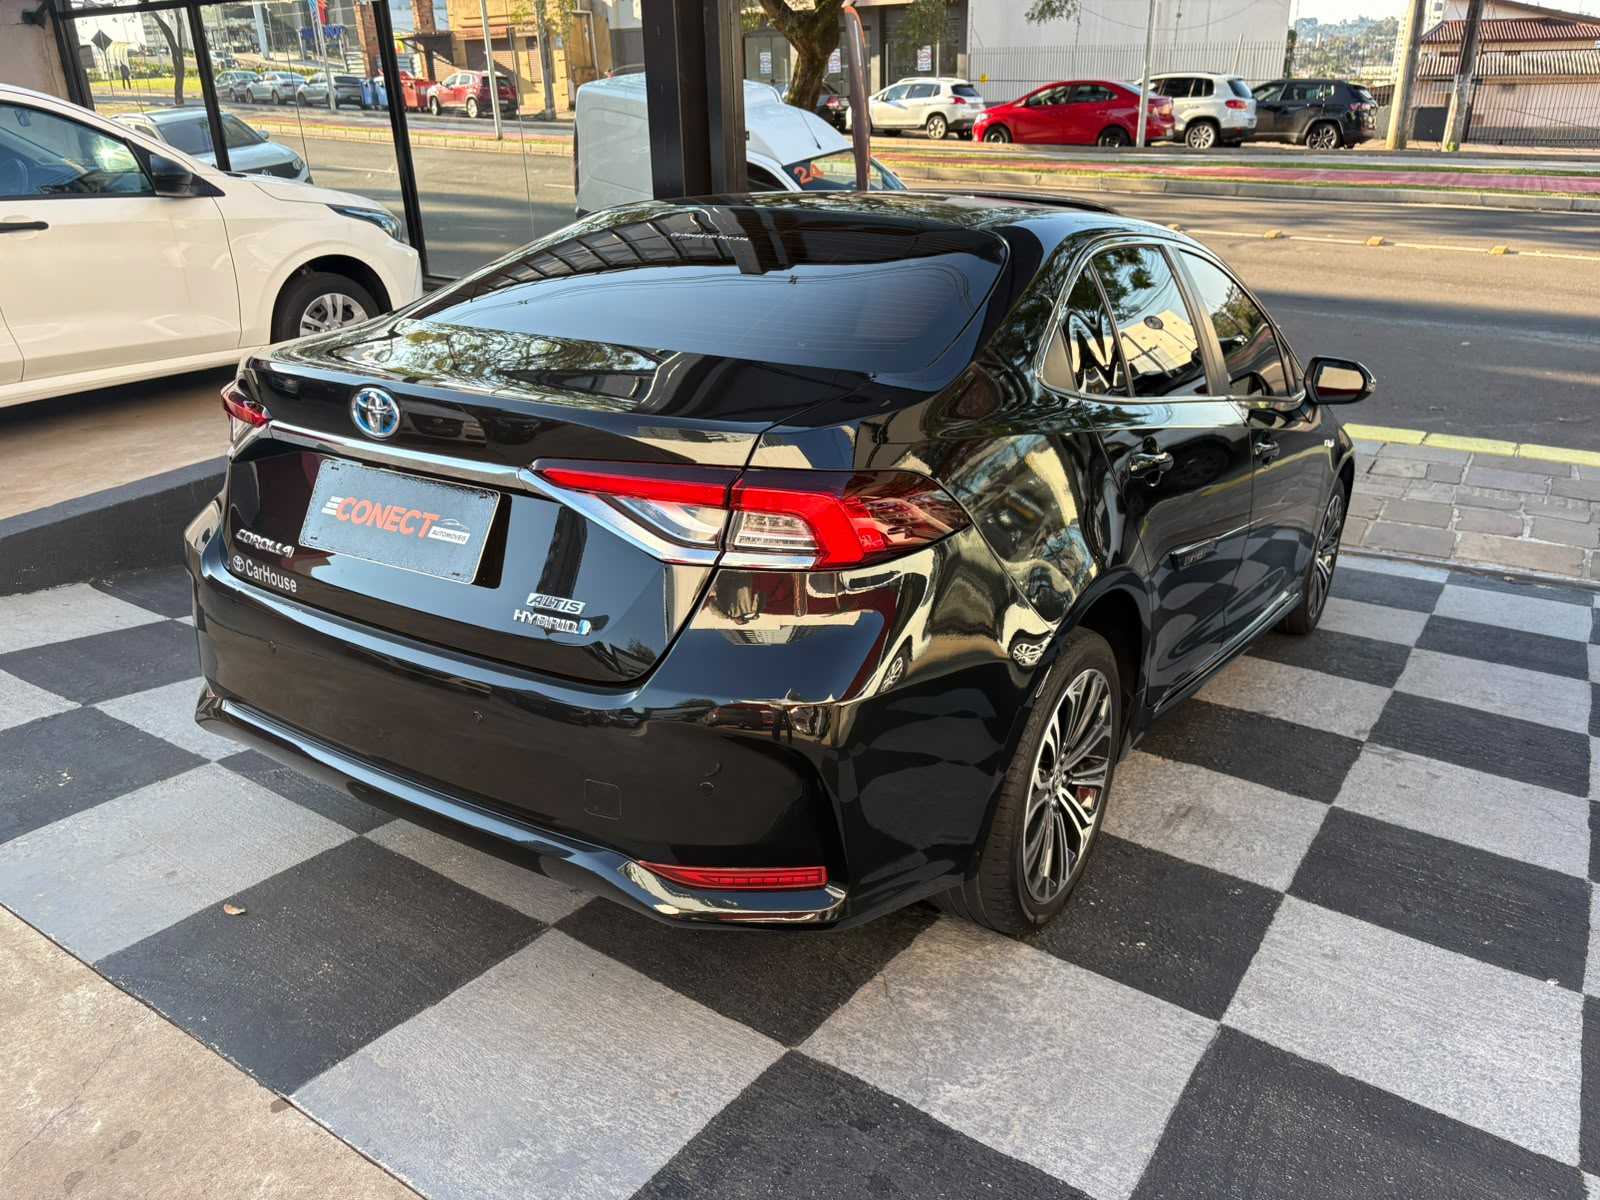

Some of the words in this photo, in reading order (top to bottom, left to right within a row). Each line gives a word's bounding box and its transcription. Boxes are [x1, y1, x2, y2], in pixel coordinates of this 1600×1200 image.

[335, 496, 440, 539] CONECT
[245, 559, 297, 593] CarHouse
[527, 594, 582, 613] ALTIS
[513, 608, 580, 635] HYBRID
